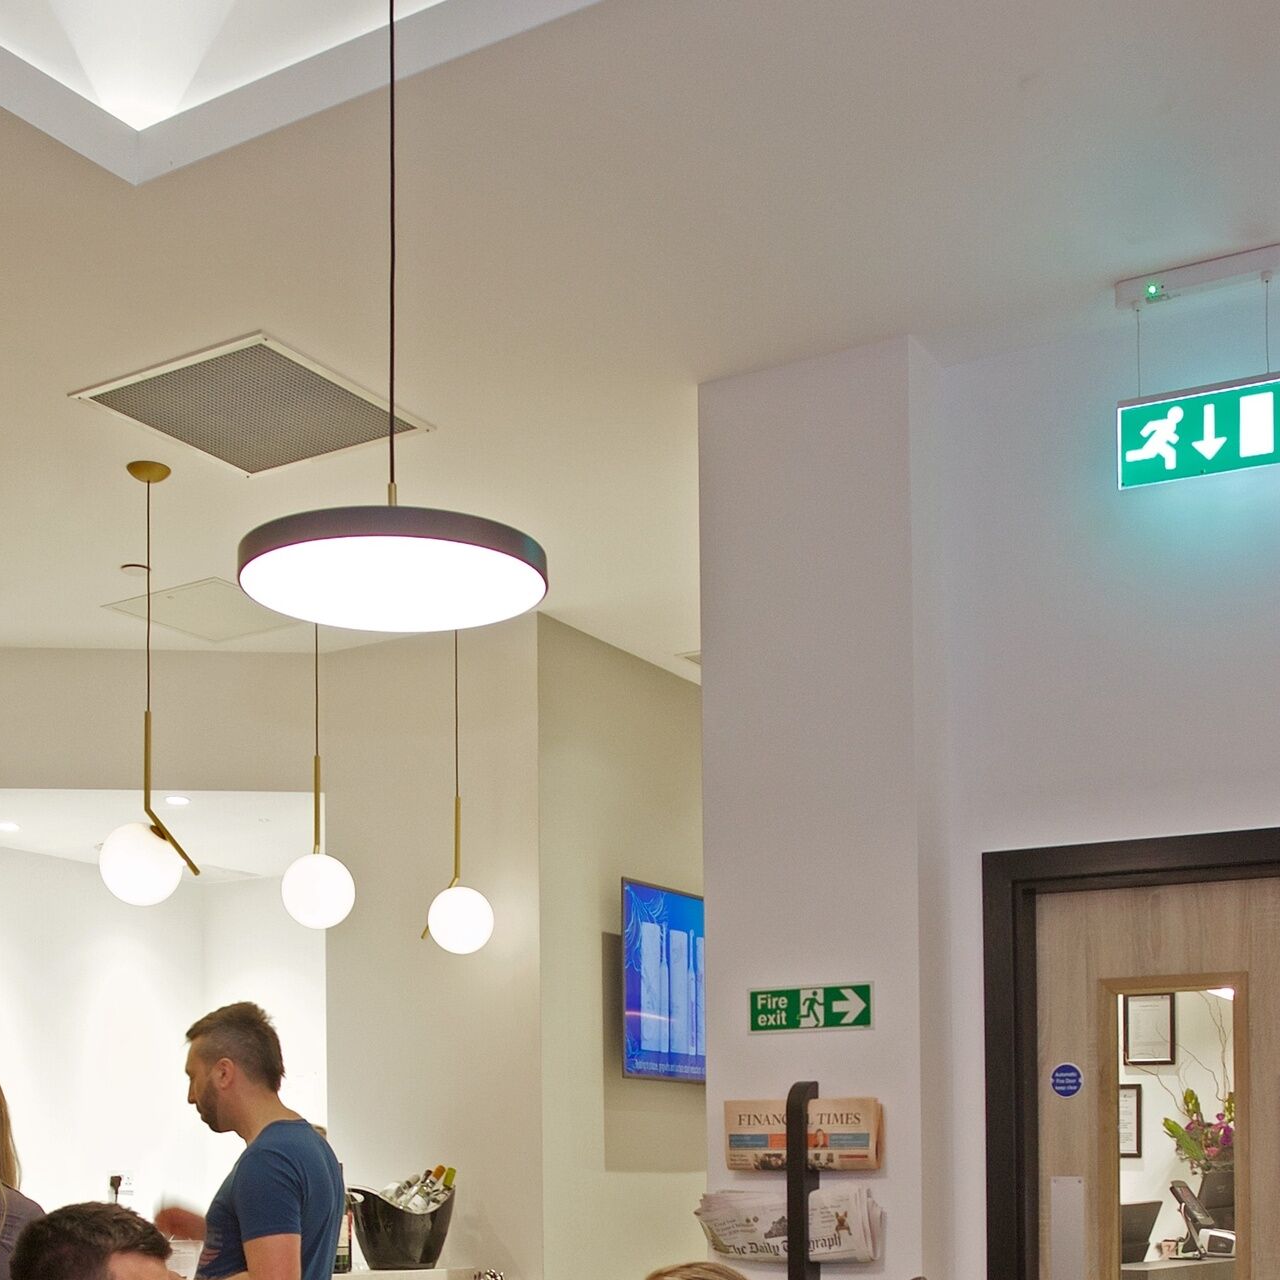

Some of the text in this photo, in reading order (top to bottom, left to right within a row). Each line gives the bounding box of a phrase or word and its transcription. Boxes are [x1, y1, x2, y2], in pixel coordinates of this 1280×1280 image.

[757, 994, 788, 1009] Fire
[757, 1010, 787, 1026] exit
[738, 1112, 861, 1126] FINANCL TIMES
[747, 1241, 780, 1256] Daily
